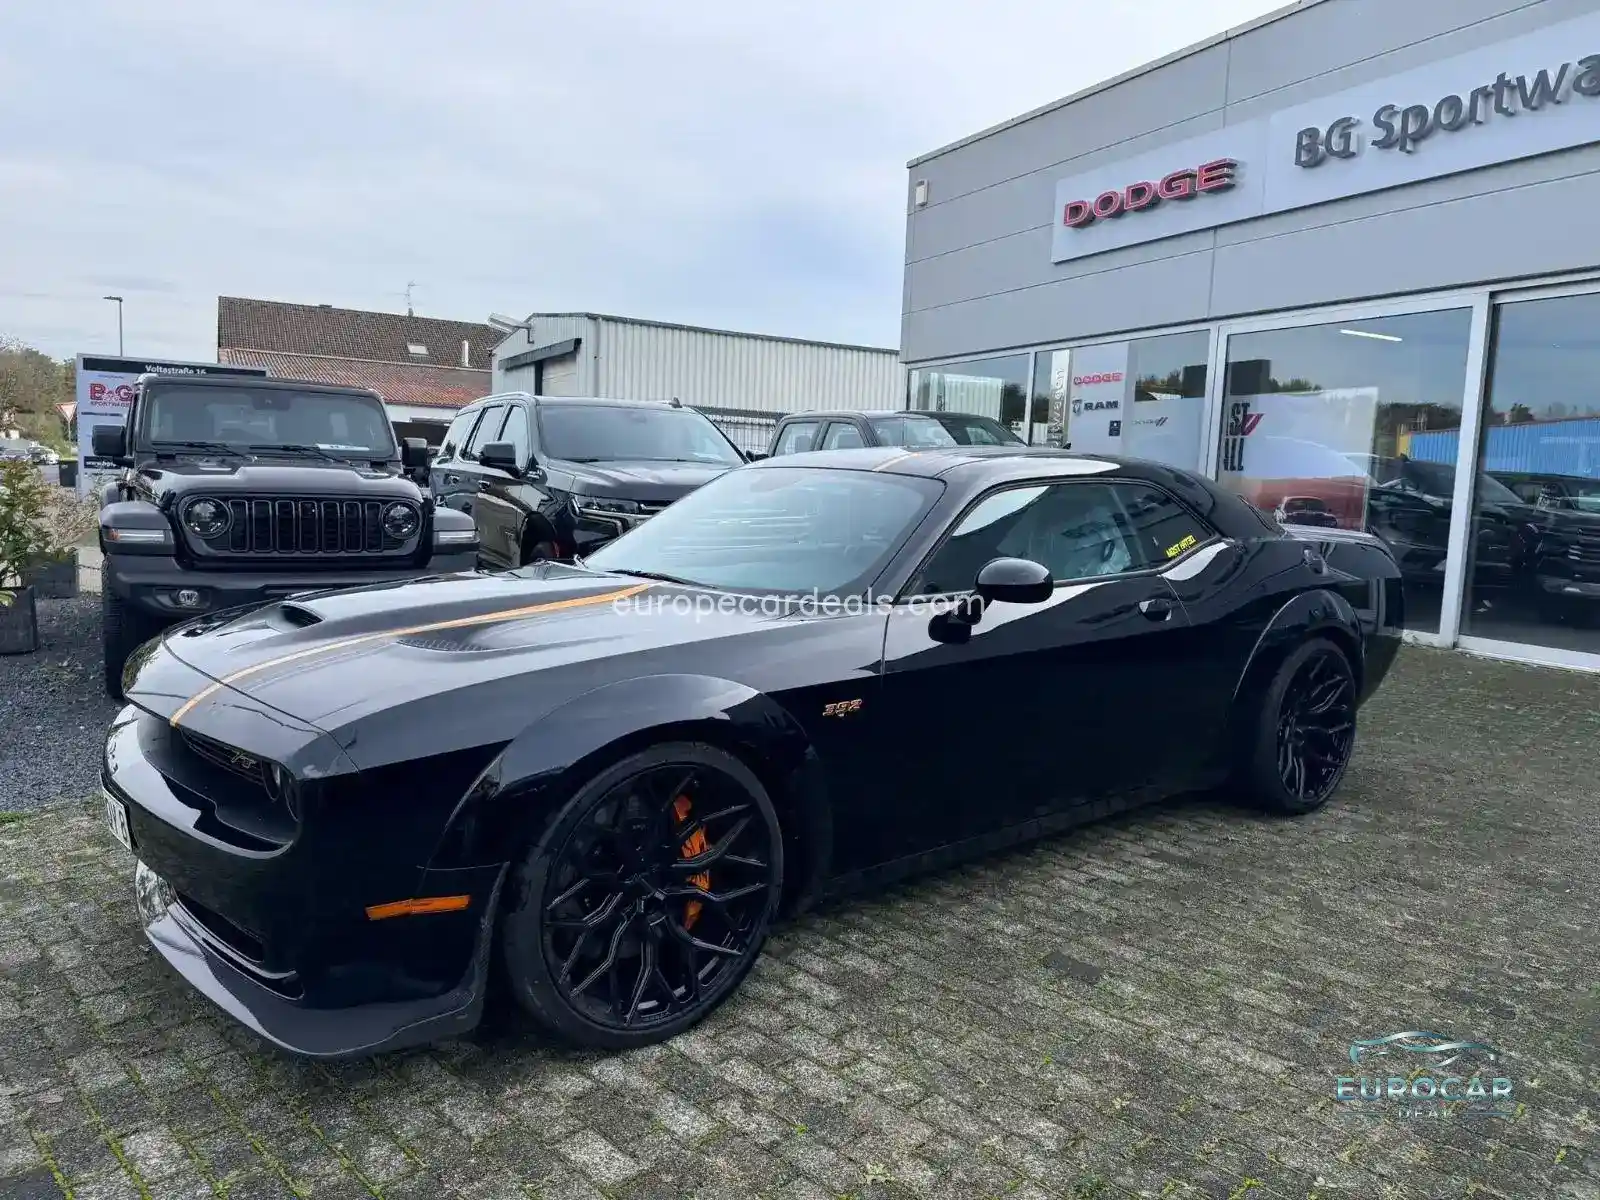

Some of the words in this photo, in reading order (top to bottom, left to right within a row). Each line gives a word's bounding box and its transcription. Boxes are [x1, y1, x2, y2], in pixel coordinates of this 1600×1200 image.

[1294, 117, 1357, 168] BG
[1371, 53, 1600, 152] Sportwa
[1063, 157, 1235, 228] DODGE
[1084, 400, 1119, 411] RAM
